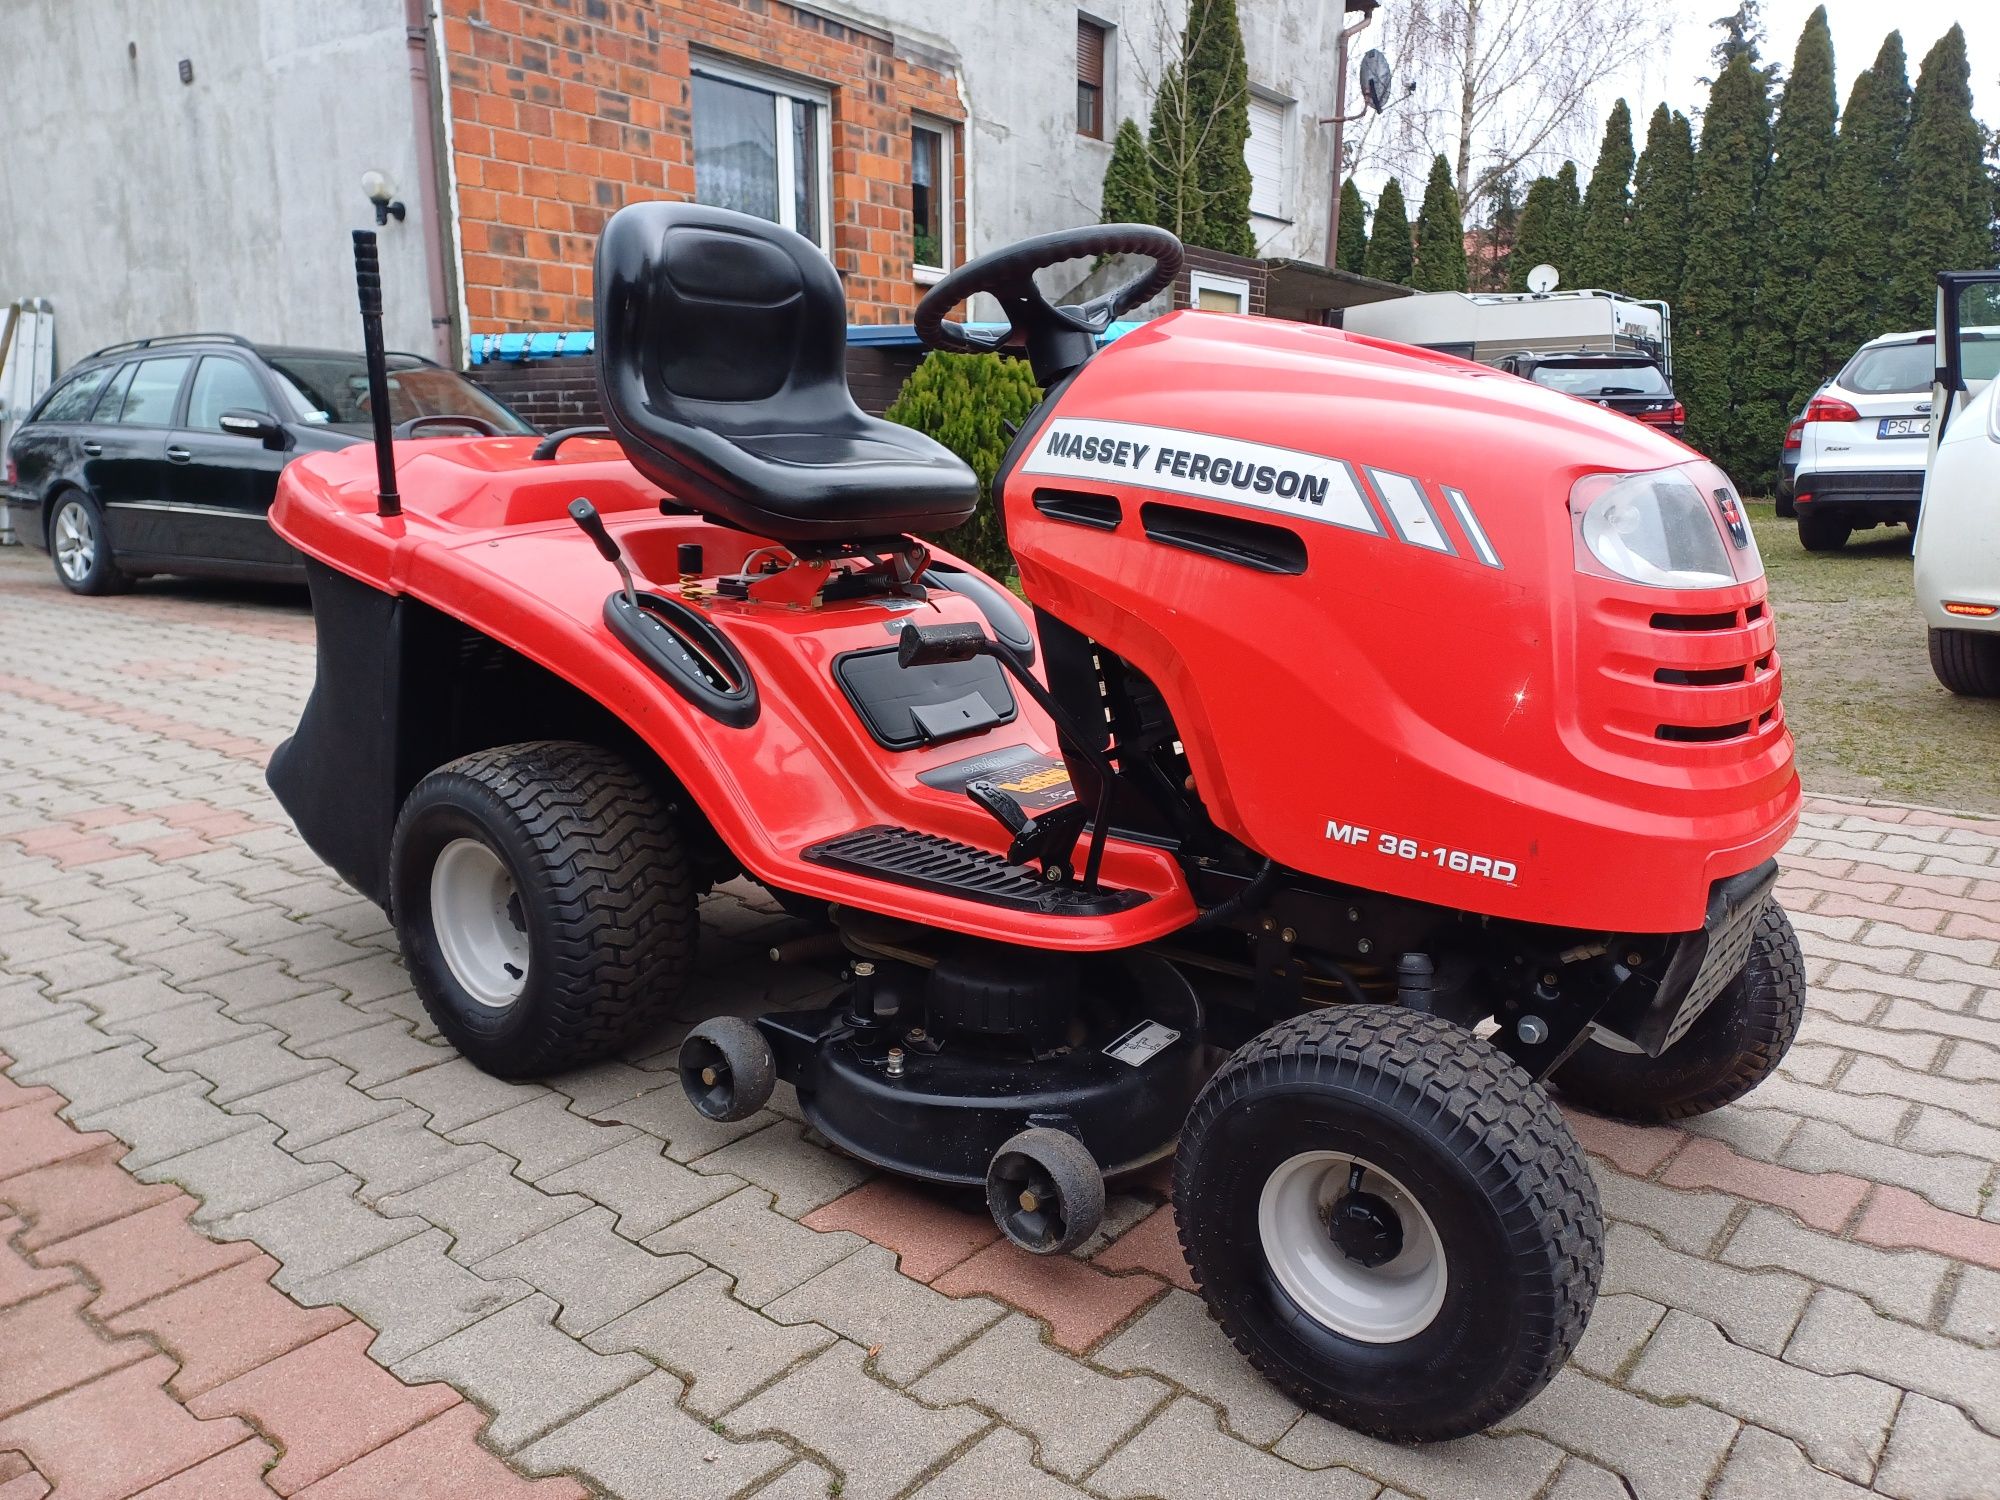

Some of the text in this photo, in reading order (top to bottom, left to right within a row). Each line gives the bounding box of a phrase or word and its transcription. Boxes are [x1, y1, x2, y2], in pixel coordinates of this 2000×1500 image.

[1887, 420, 1916, 435] PSL
[1046, 431, 1330, 506] MASSEY FERGUSON
[1325, 820, 1370, 846] MF
